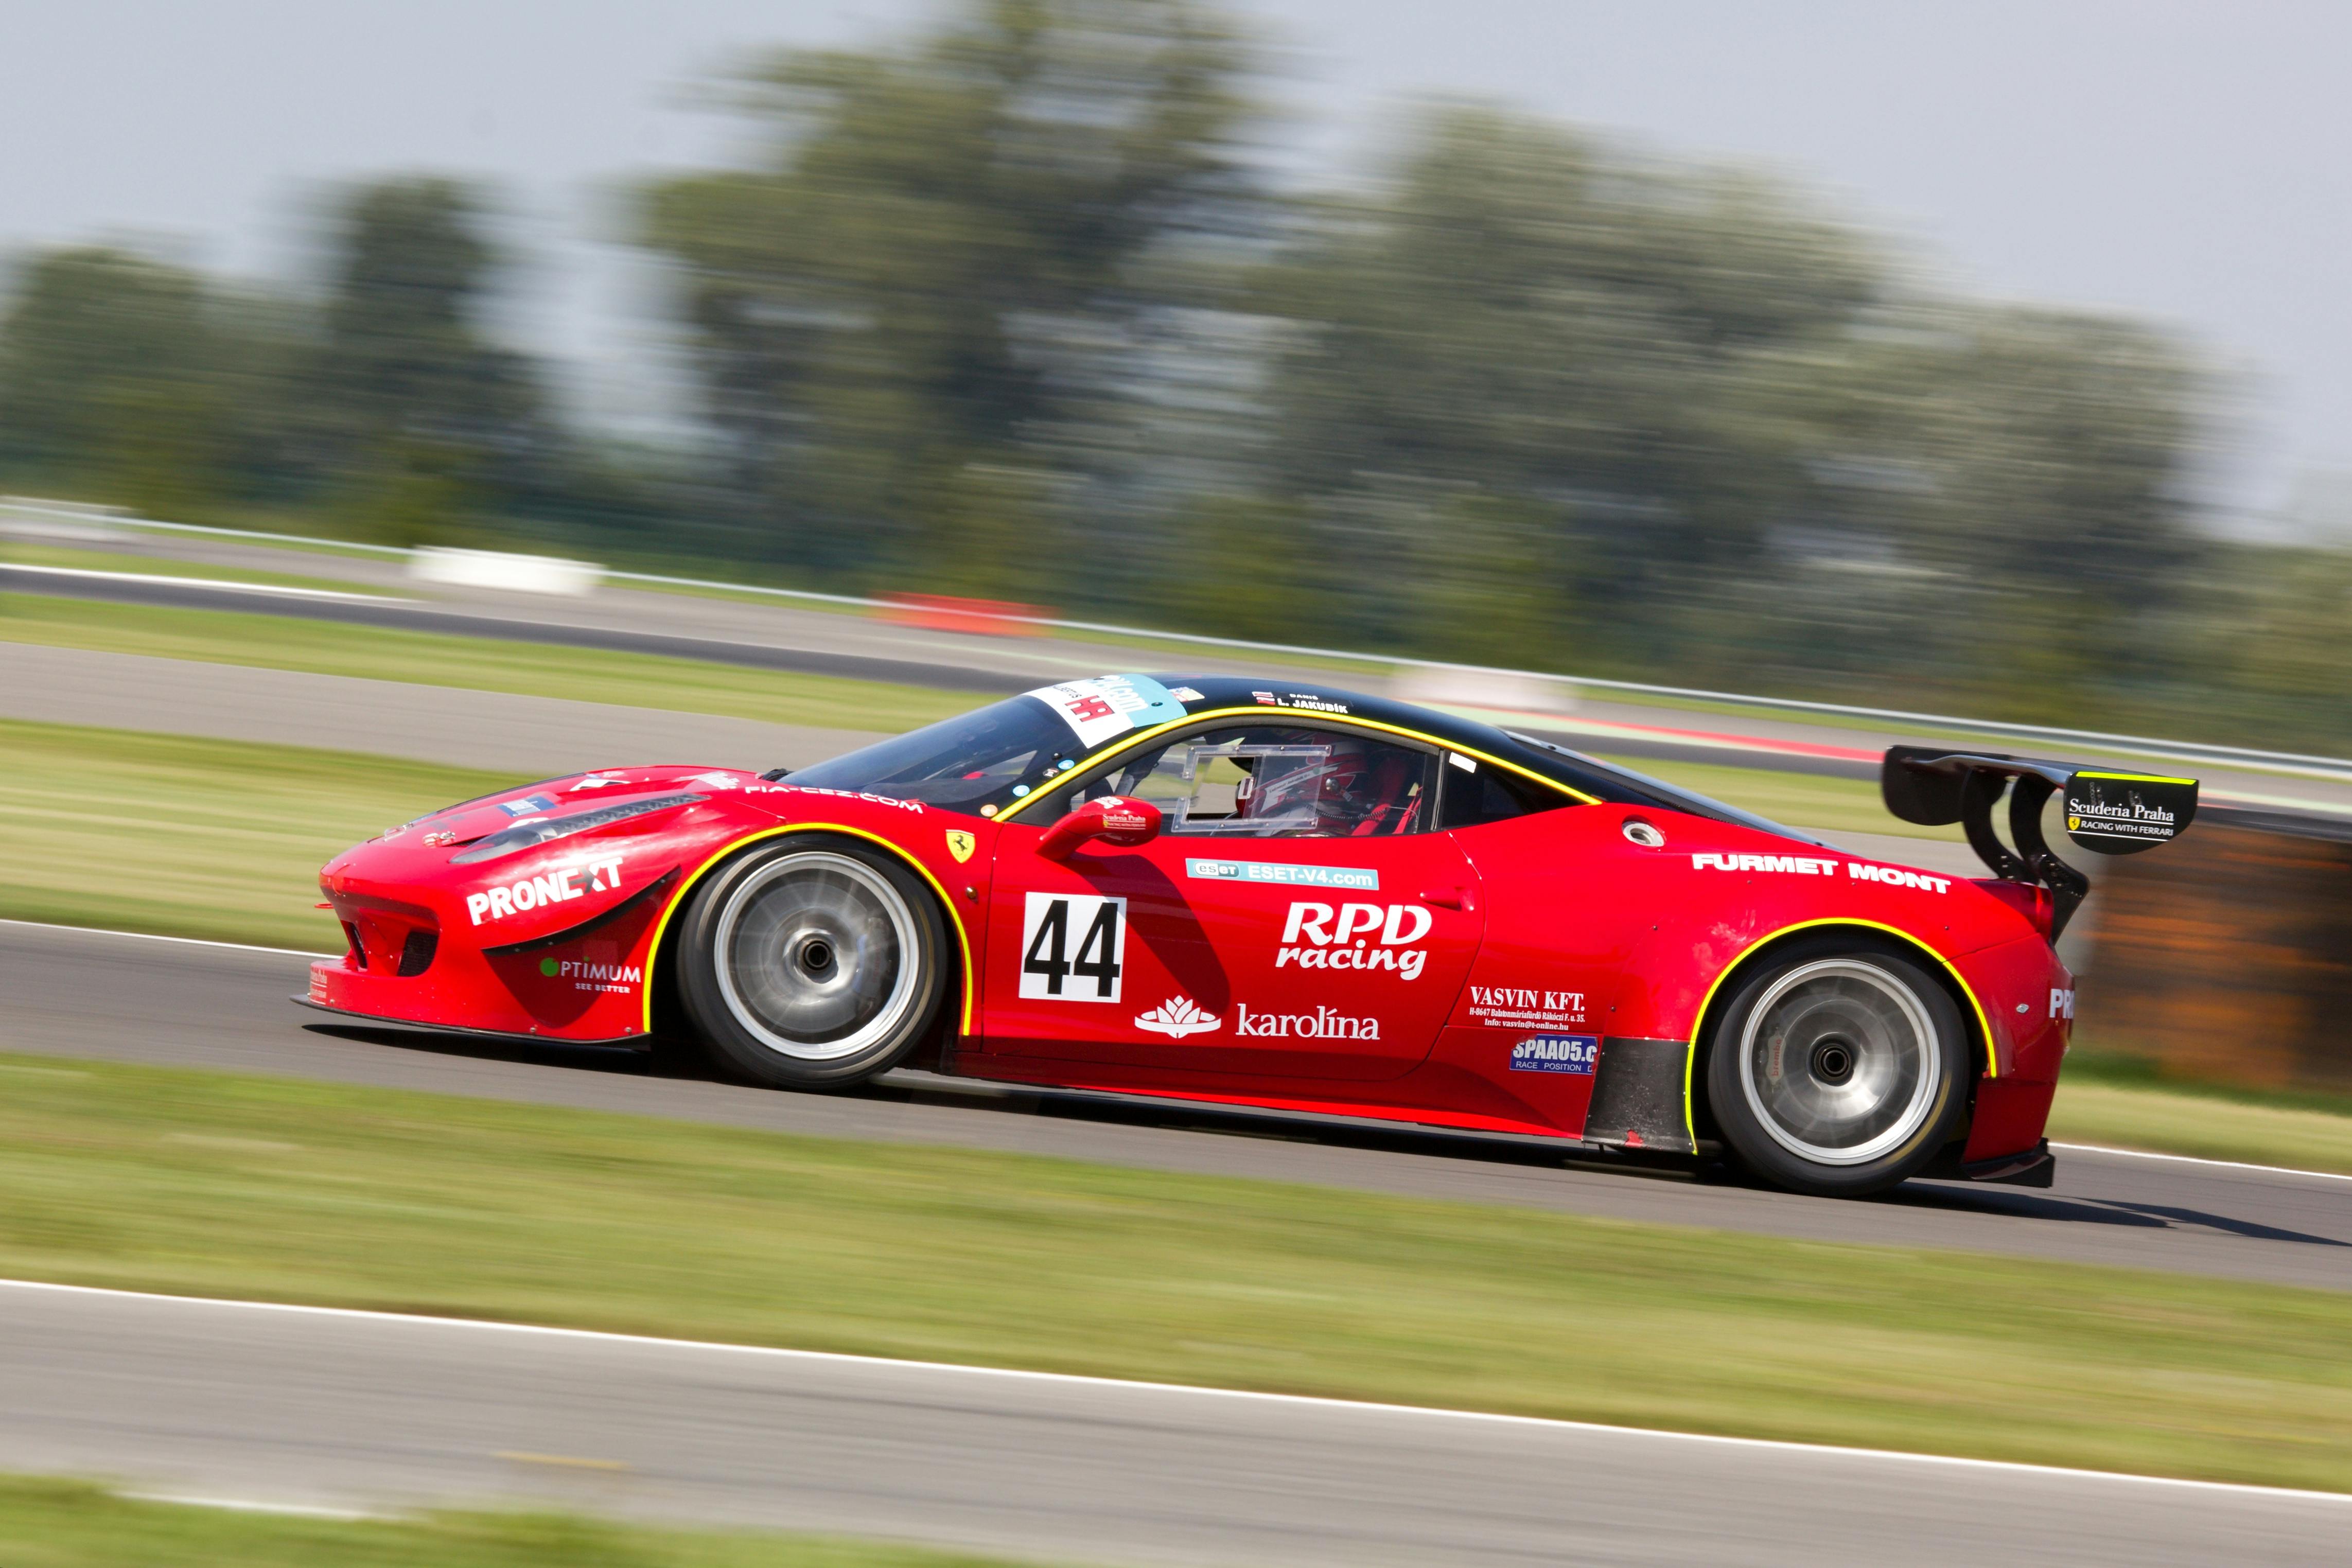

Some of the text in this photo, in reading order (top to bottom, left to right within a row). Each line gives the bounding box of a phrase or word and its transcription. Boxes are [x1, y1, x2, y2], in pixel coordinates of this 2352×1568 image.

[1277, 698, 1289, 707] L.
[2069, 798, 2130, 817] Scuderia
[2134, 804, 2174, 821] Praha
[2081, 820, 2173, 836] RACING WITH FERRARI
[1248, 865, 1373, 886] ESET-V4.com
[1692, 853, 1951, 894] FURMET MONT
[467, 857, 623, 926] PRONEXT
[1282, 902, 1432, 946] RPD
[1024, 900, 1120, 997] 44
[1275, 939, 1427, 980] racing
[575, 982, 630, 994] SEE BETTER
[1470, 986, 1585, 1011] VASVIN KFT.
[1469, 1007, 1490, 1016] H-8647
[1542, 1012, 1564, 1021] Rákóczi
[2049, 989, 2075, 1019] PR
[1235, 1003, 1380, 1040] karolína
[1502, 1020, 1569, 1031] vasvin@t-online.hu
[1516, 1061, 1538, 1069] RACE
[1544, 1063, 1582, 1071] POSITION
